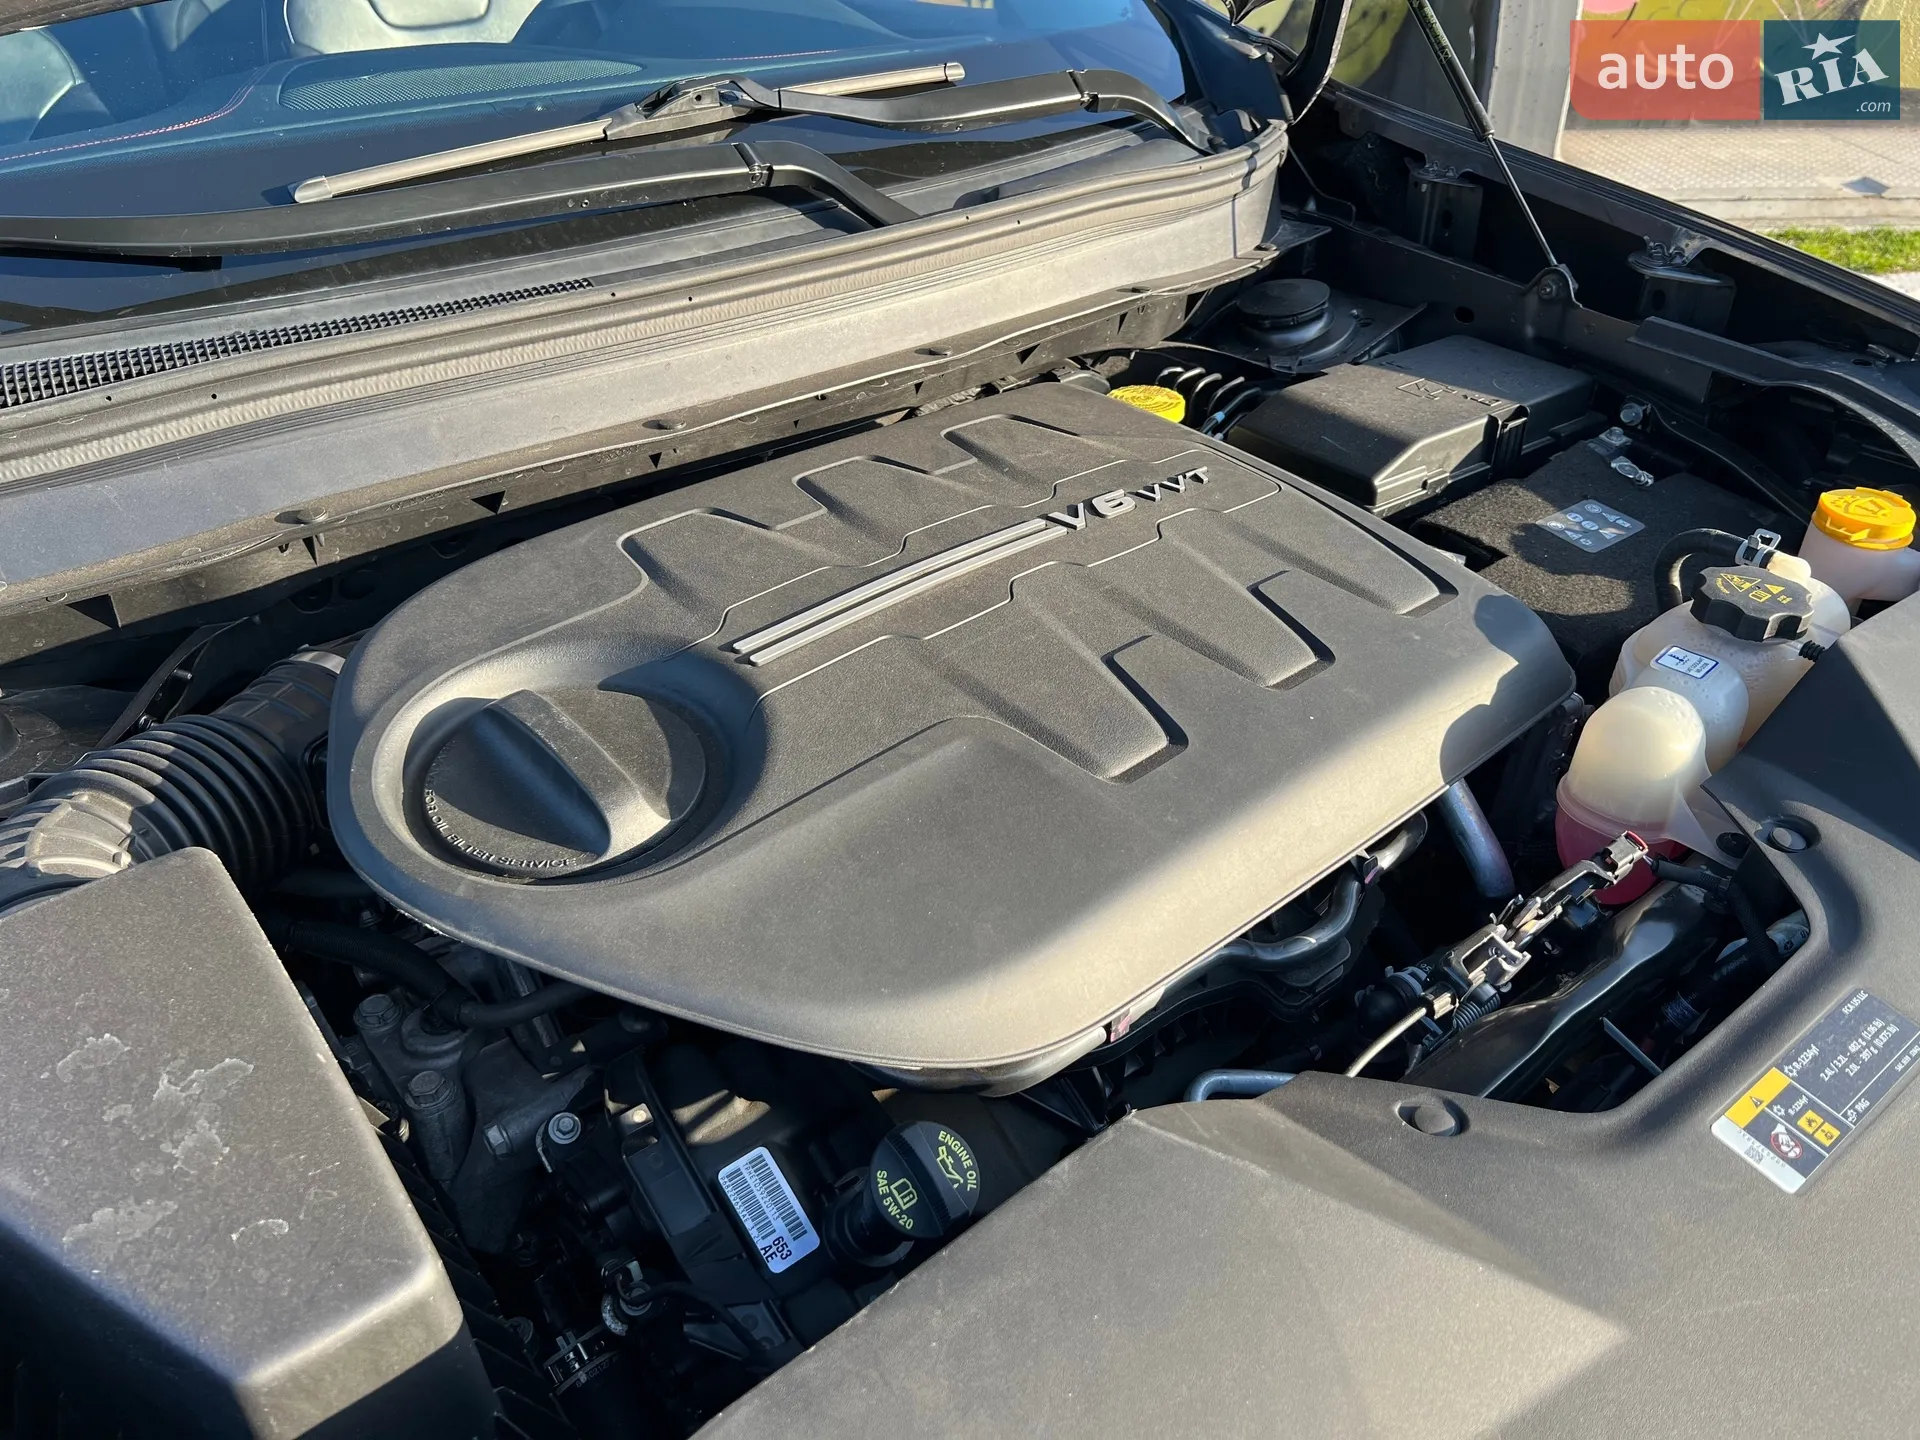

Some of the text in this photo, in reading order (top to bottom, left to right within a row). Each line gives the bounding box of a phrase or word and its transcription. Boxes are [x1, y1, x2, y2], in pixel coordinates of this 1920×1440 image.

[1047, 466, 1208, 530] V6 VVT
[424, 789, 577, 869] FOR OIL FILTER SERVICE
[1857, 990, 1869, 1001] LLC
[1854, 1098, 1871, 1113] PAG
[938, 1130, 977, 1192] ENGINE OIL
[877, 1170, 914, 1230] SAE 5W-20
[760, 1244, 778, 1264] AE
[772, 1235, 793, 1261] 653
